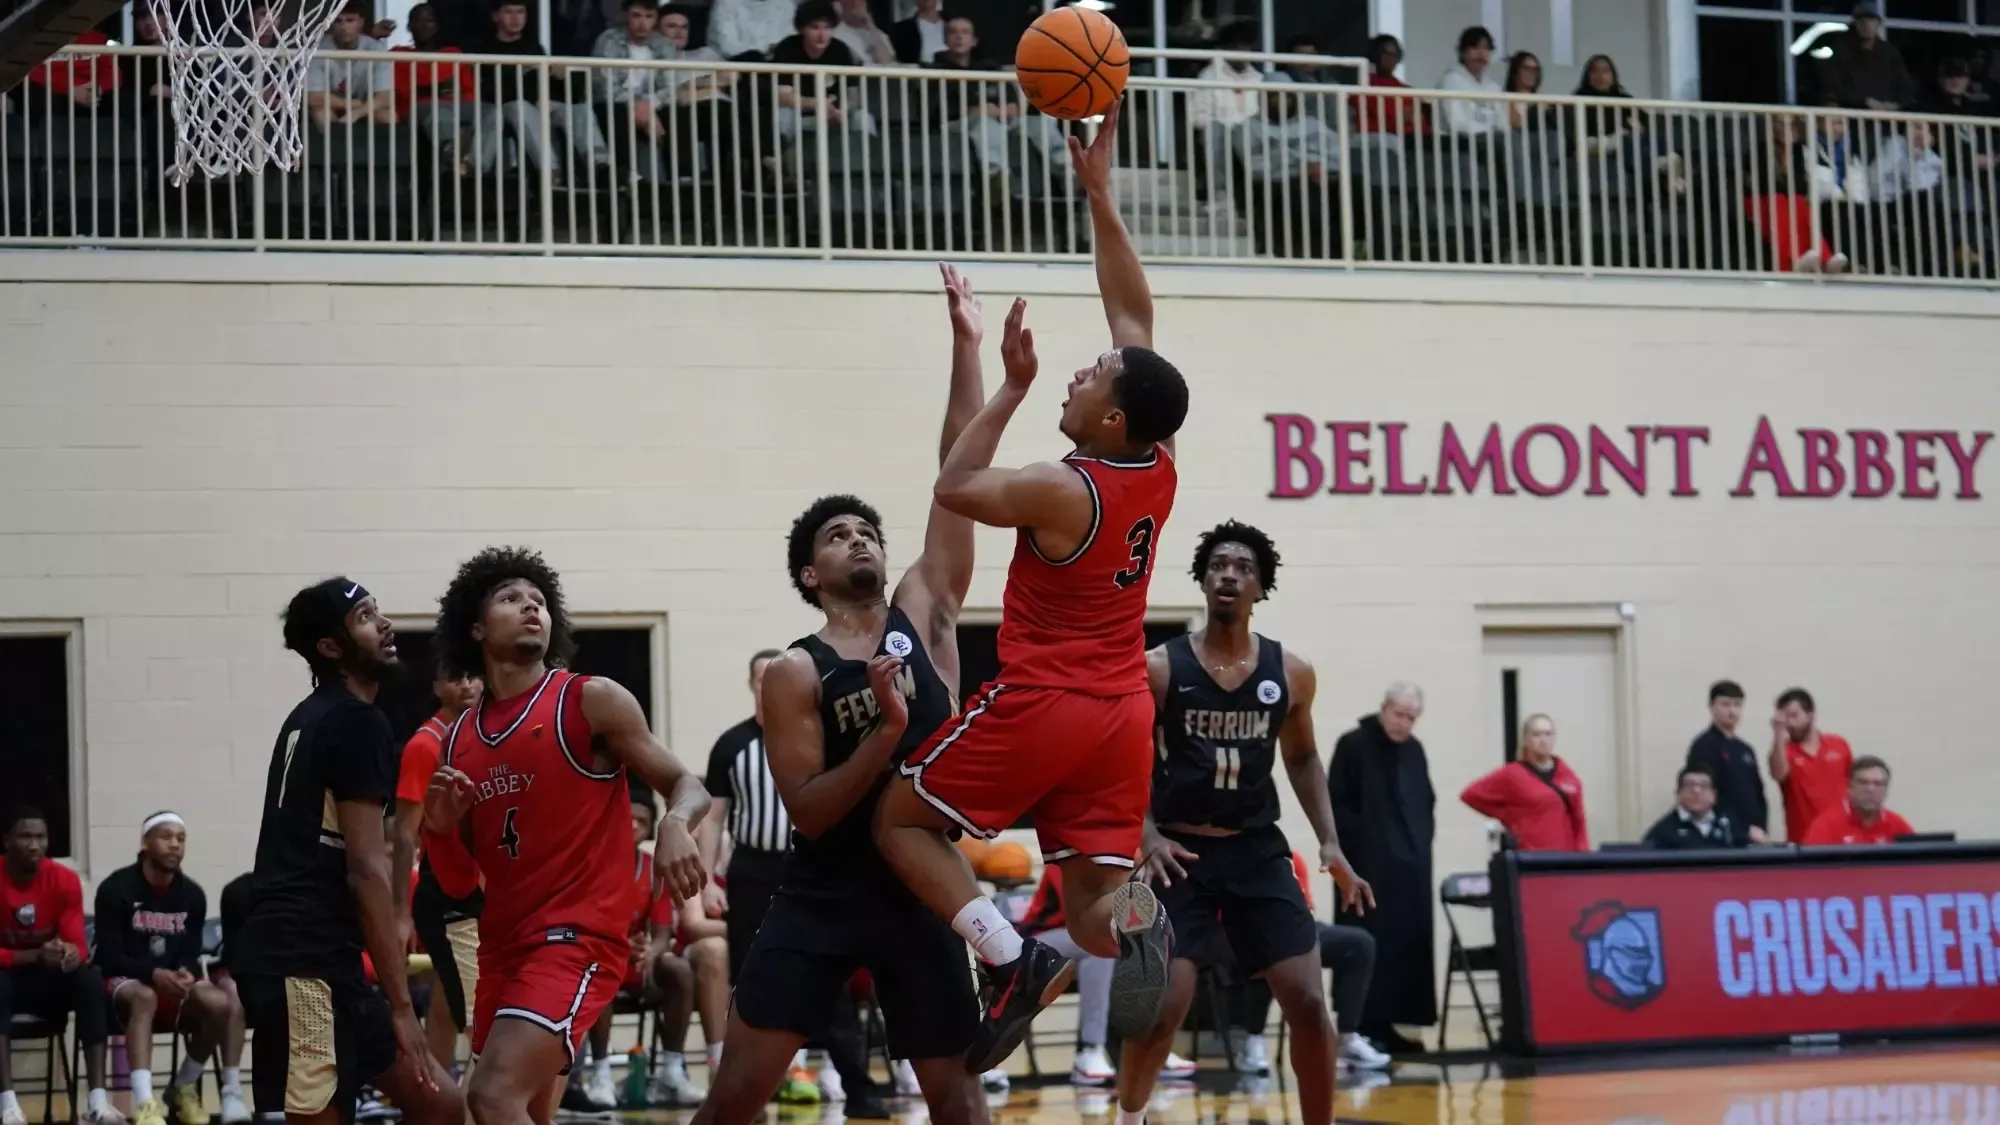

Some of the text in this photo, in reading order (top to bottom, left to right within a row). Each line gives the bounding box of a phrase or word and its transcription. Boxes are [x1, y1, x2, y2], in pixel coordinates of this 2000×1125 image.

[1264, 412, 1995, 500] BELMONT ABBEY
[1113, 515, 1155, 589] 3
[833, 664, 917, 734] FERM
[1184, 708, 1271, 740] FERRUM
[488, 763, 512, 778] THE
[1213, 746, 1241, 790] 11
[497, 806, 520, 860] 4
